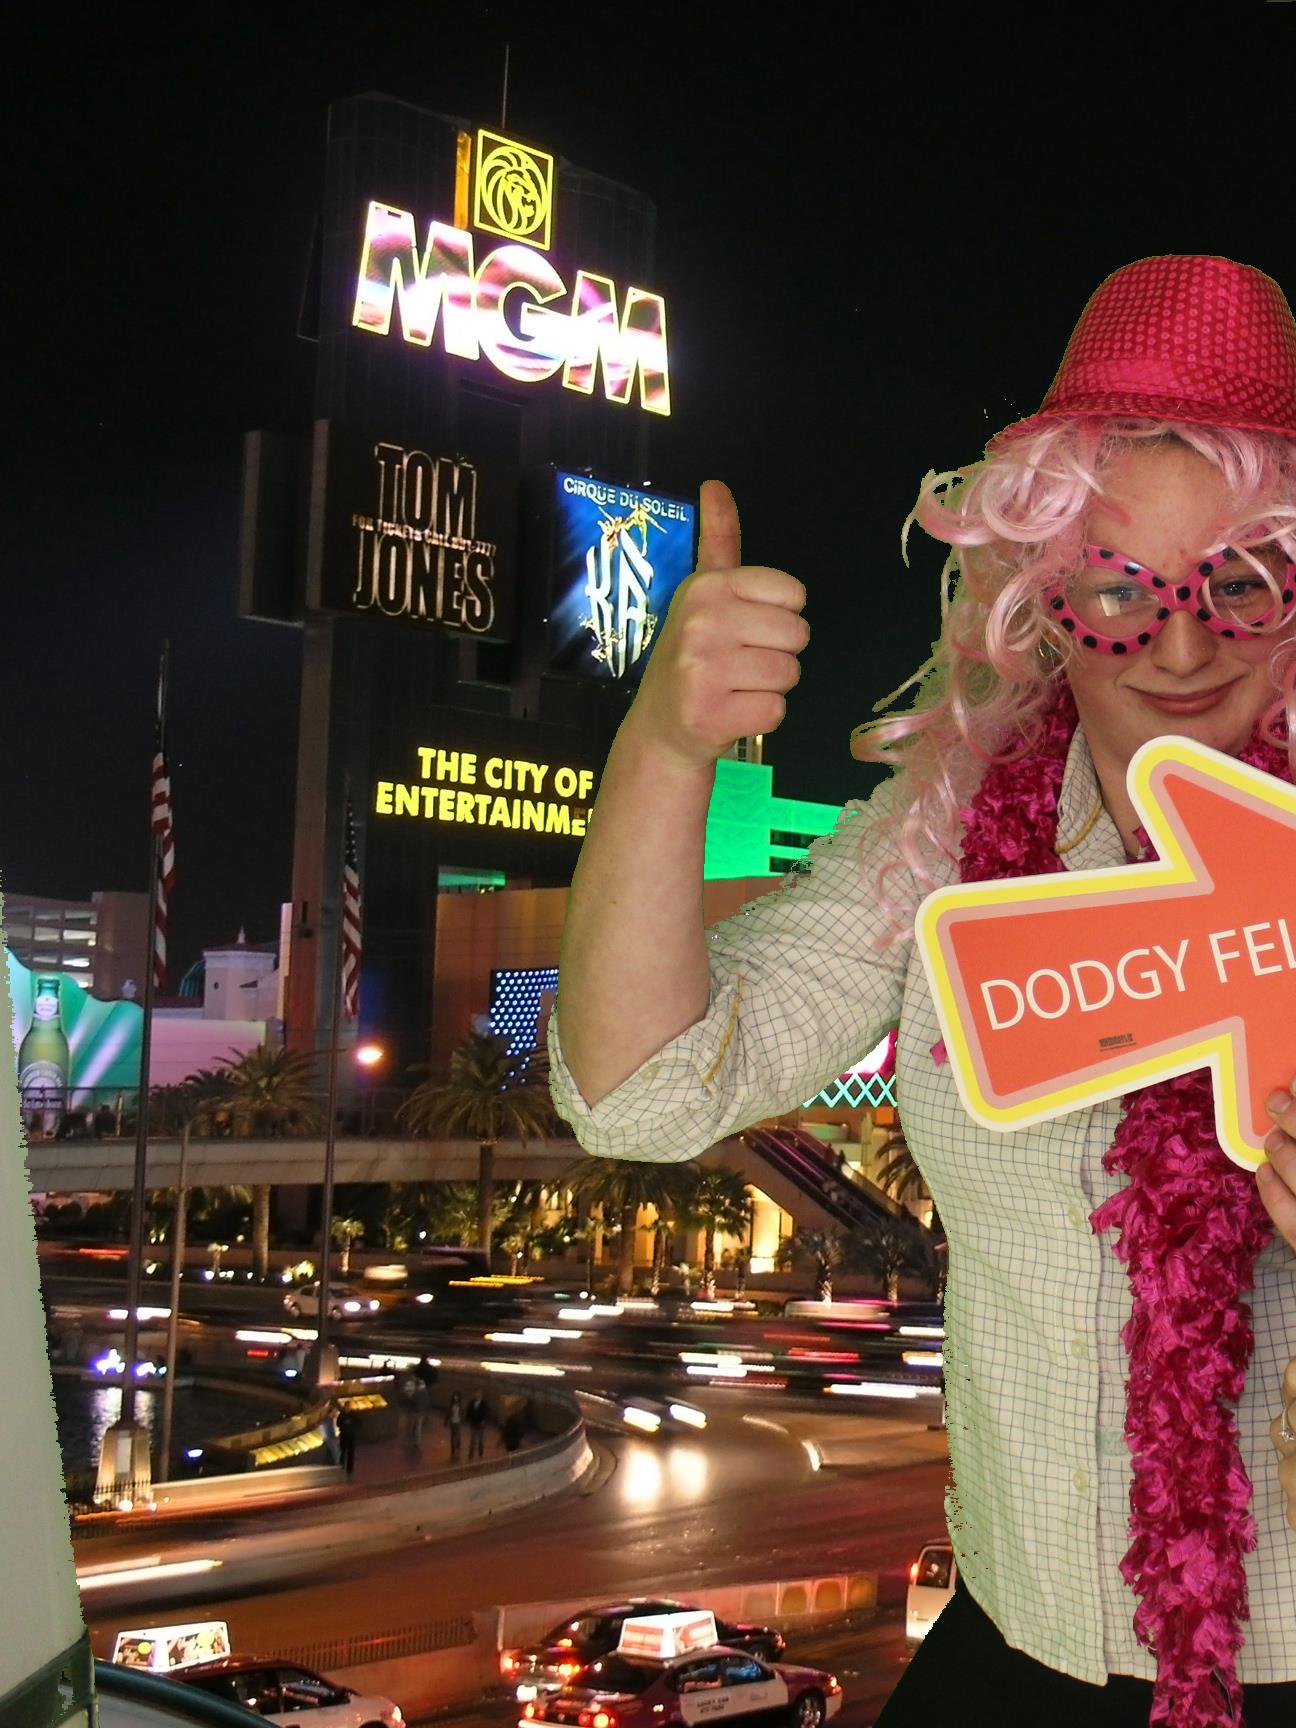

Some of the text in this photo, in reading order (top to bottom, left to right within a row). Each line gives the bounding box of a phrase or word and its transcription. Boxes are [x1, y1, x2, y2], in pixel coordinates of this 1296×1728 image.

[353, 200, 671, 416] MGM
[374, 442, 477, 541] TOM
[619, 491, 640, 510] DU
[353, 530, 495, 632] JONES
[376, 781, 593, 837] ENTERTAINME
[418, 746, 594, 800] THE CITY OF
[980, 939, 1190, 1030] DODGY
